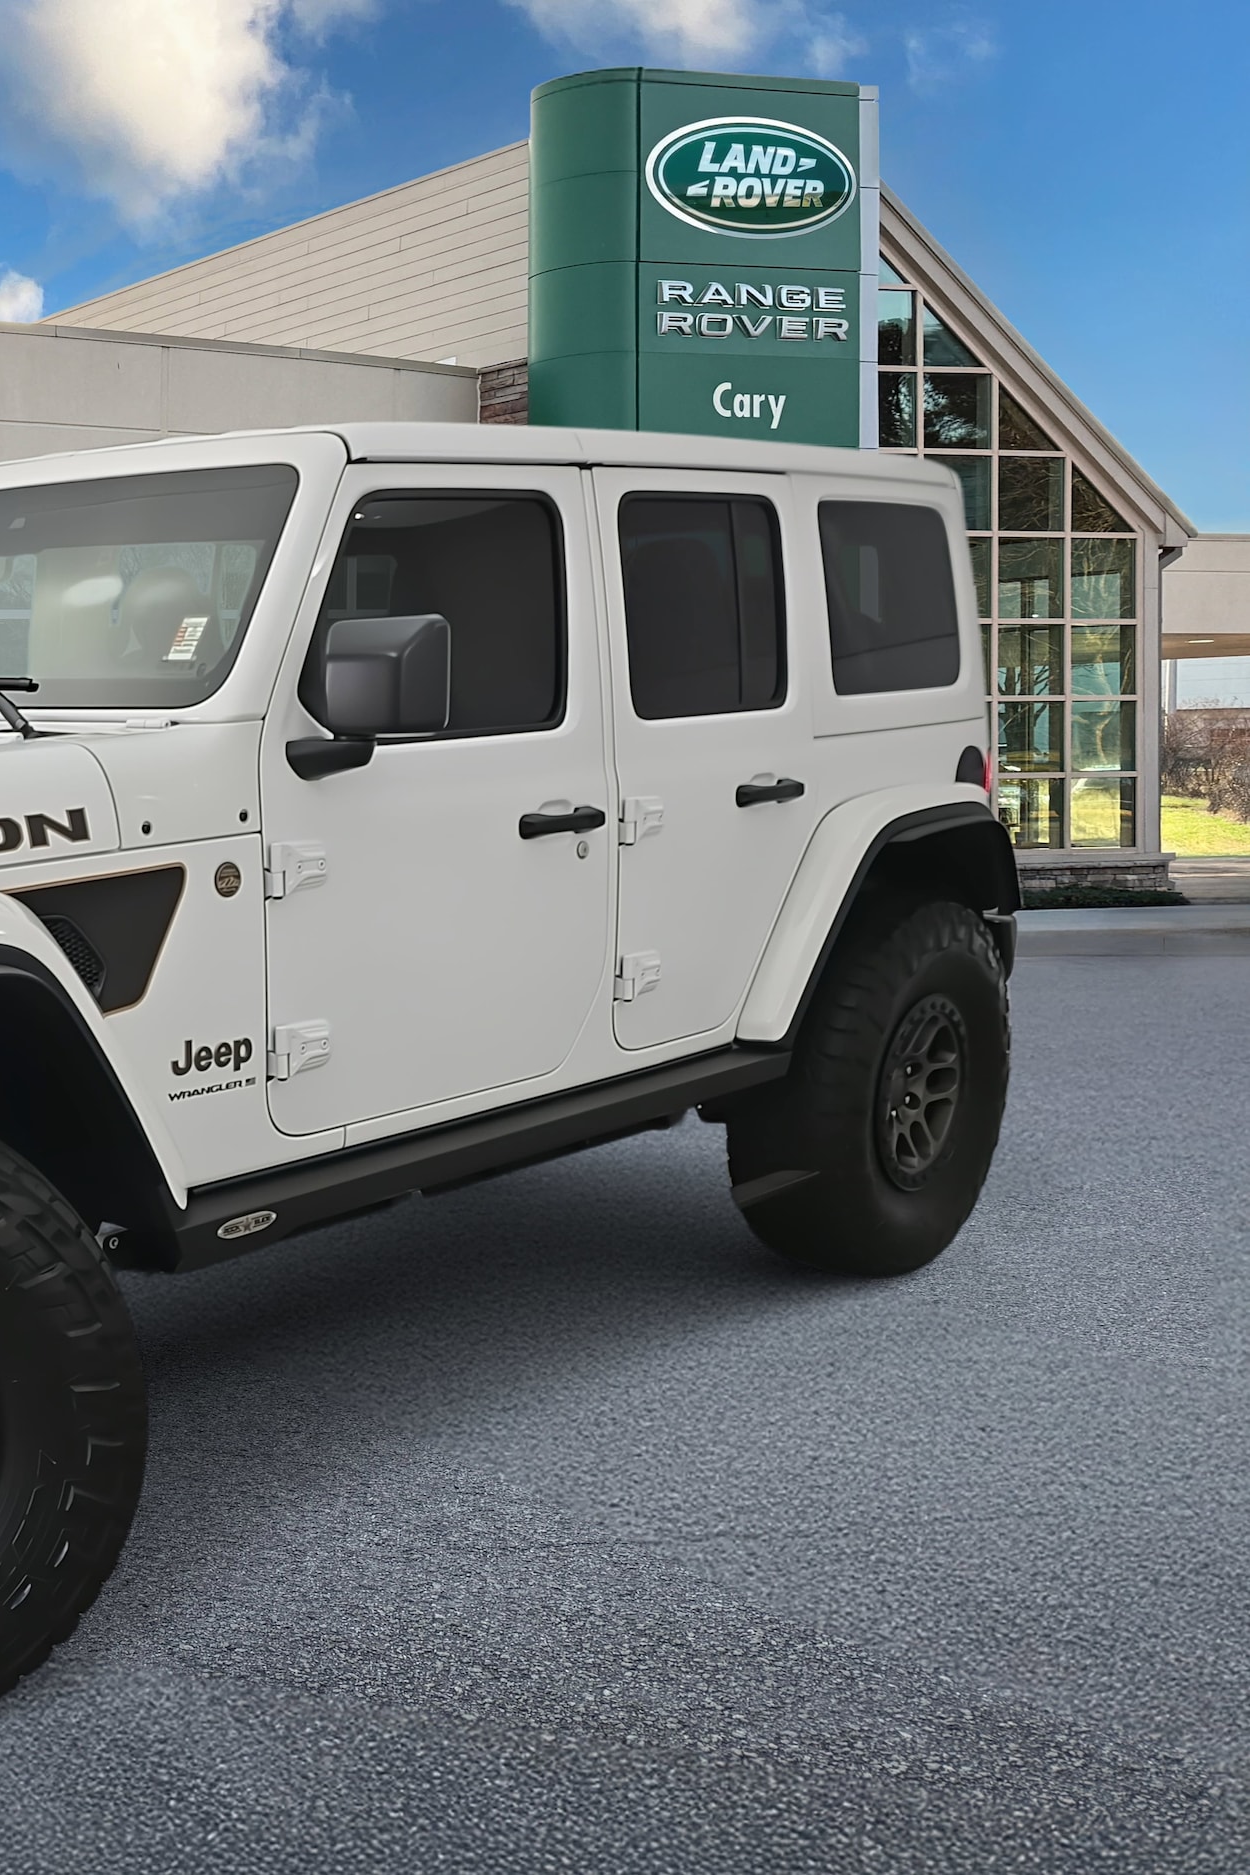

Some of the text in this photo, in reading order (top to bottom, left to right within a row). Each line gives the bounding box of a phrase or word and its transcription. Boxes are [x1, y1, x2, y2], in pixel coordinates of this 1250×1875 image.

[697, 141, 797, 175] LAND
[710, 176, 825, 208] ROVER
[657, 280, 846, 312] RANGE
[657, 311, 849, 342] ROVER
[712, 382, 787, 429] Cary
[171, 1037, 253, 1076] Jeep
[168, 1080, 243, 1102] WRANGLER
